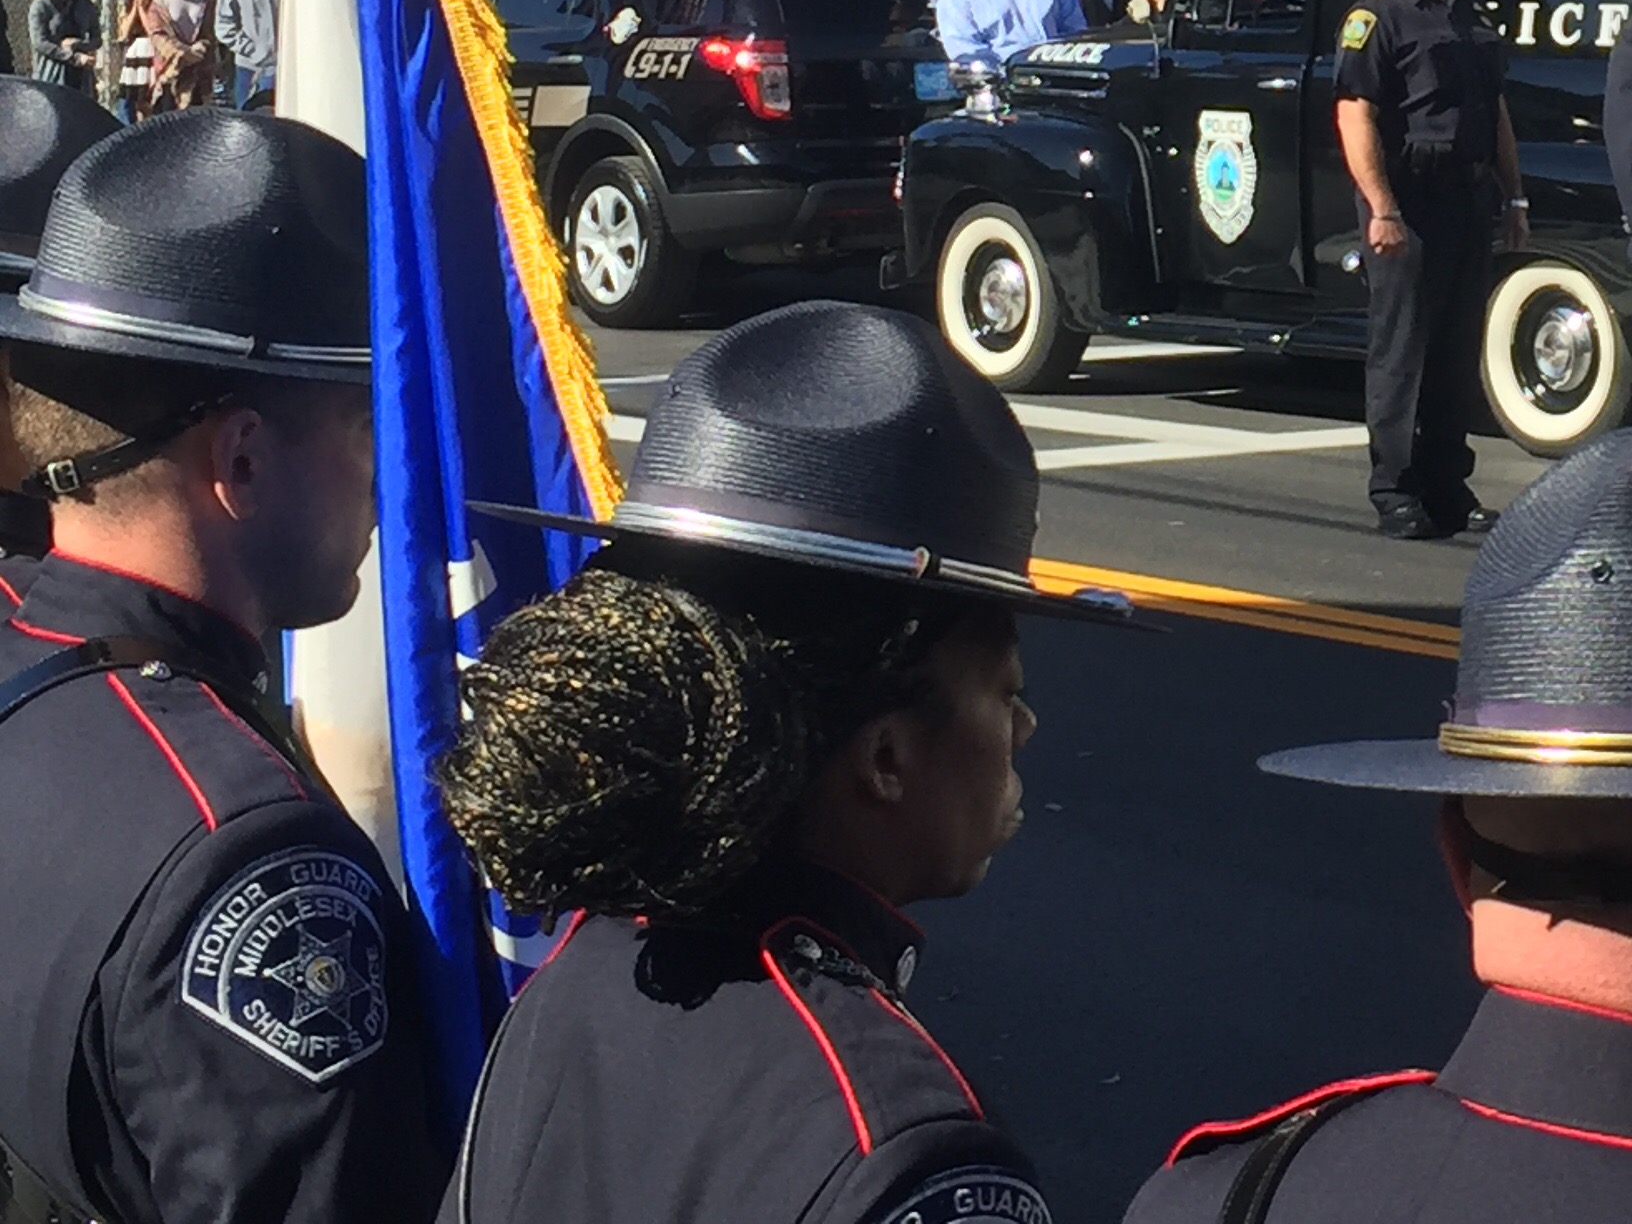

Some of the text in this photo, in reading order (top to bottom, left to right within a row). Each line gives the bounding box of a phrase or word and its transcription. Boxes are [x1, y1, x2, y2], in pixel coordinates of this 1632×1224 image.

[634, 52, 693, 80] 9-1-1
[1028, 43, 1111, 64] POLICE
[194, 862, 371, 978] HONOR GUARD
[233, 897, 357, 978] MIDDLESEX
